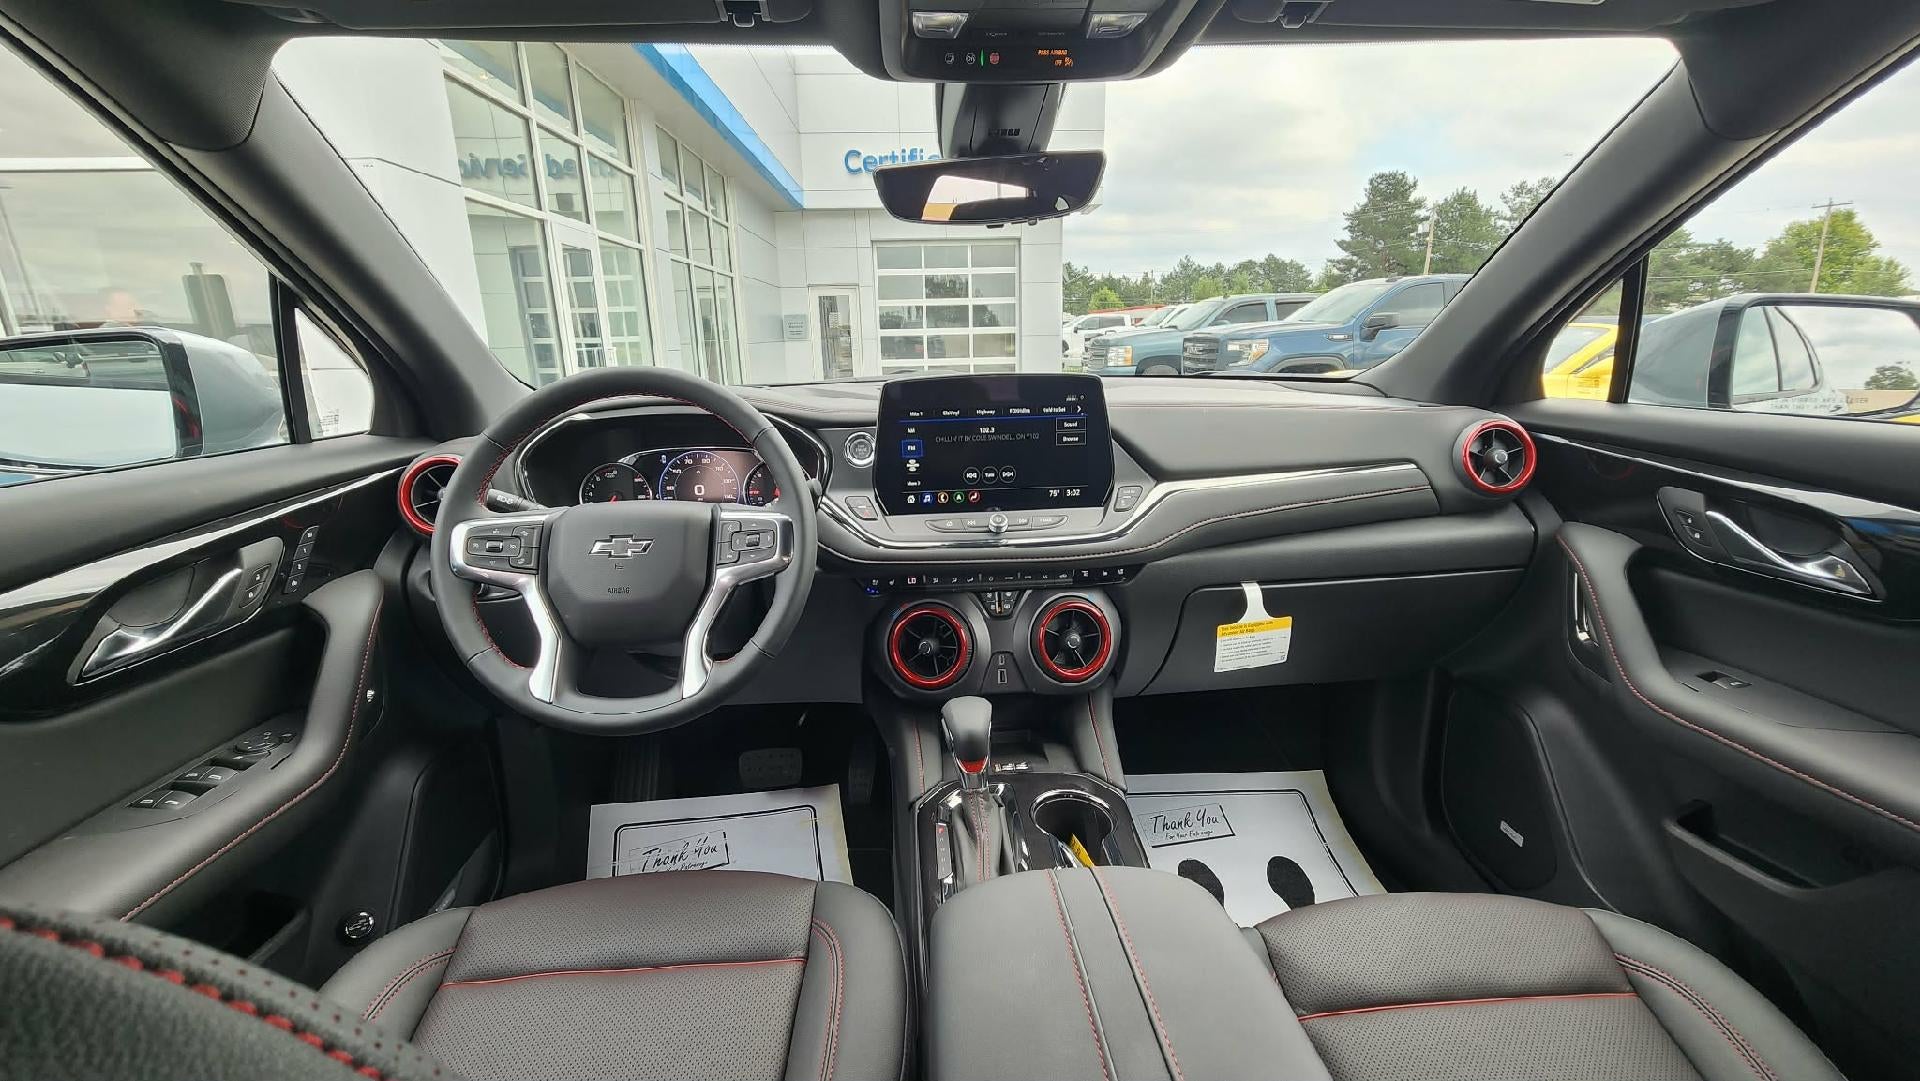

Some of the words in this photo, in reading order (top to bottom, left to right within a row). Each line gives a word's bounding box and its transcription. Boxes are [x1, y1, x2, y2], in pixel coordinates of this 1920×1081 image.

[844, 147, 940, 173] Certifi
[694, 484, 705, 496] 0
[1066, 489, 1081, 497] 3:02
[1150, 811, 1194, 834] Thank
[1196, 808, 1219, 828] You
[642, 841, 690, 872] Thank
[694, 836, 718, 859] You
